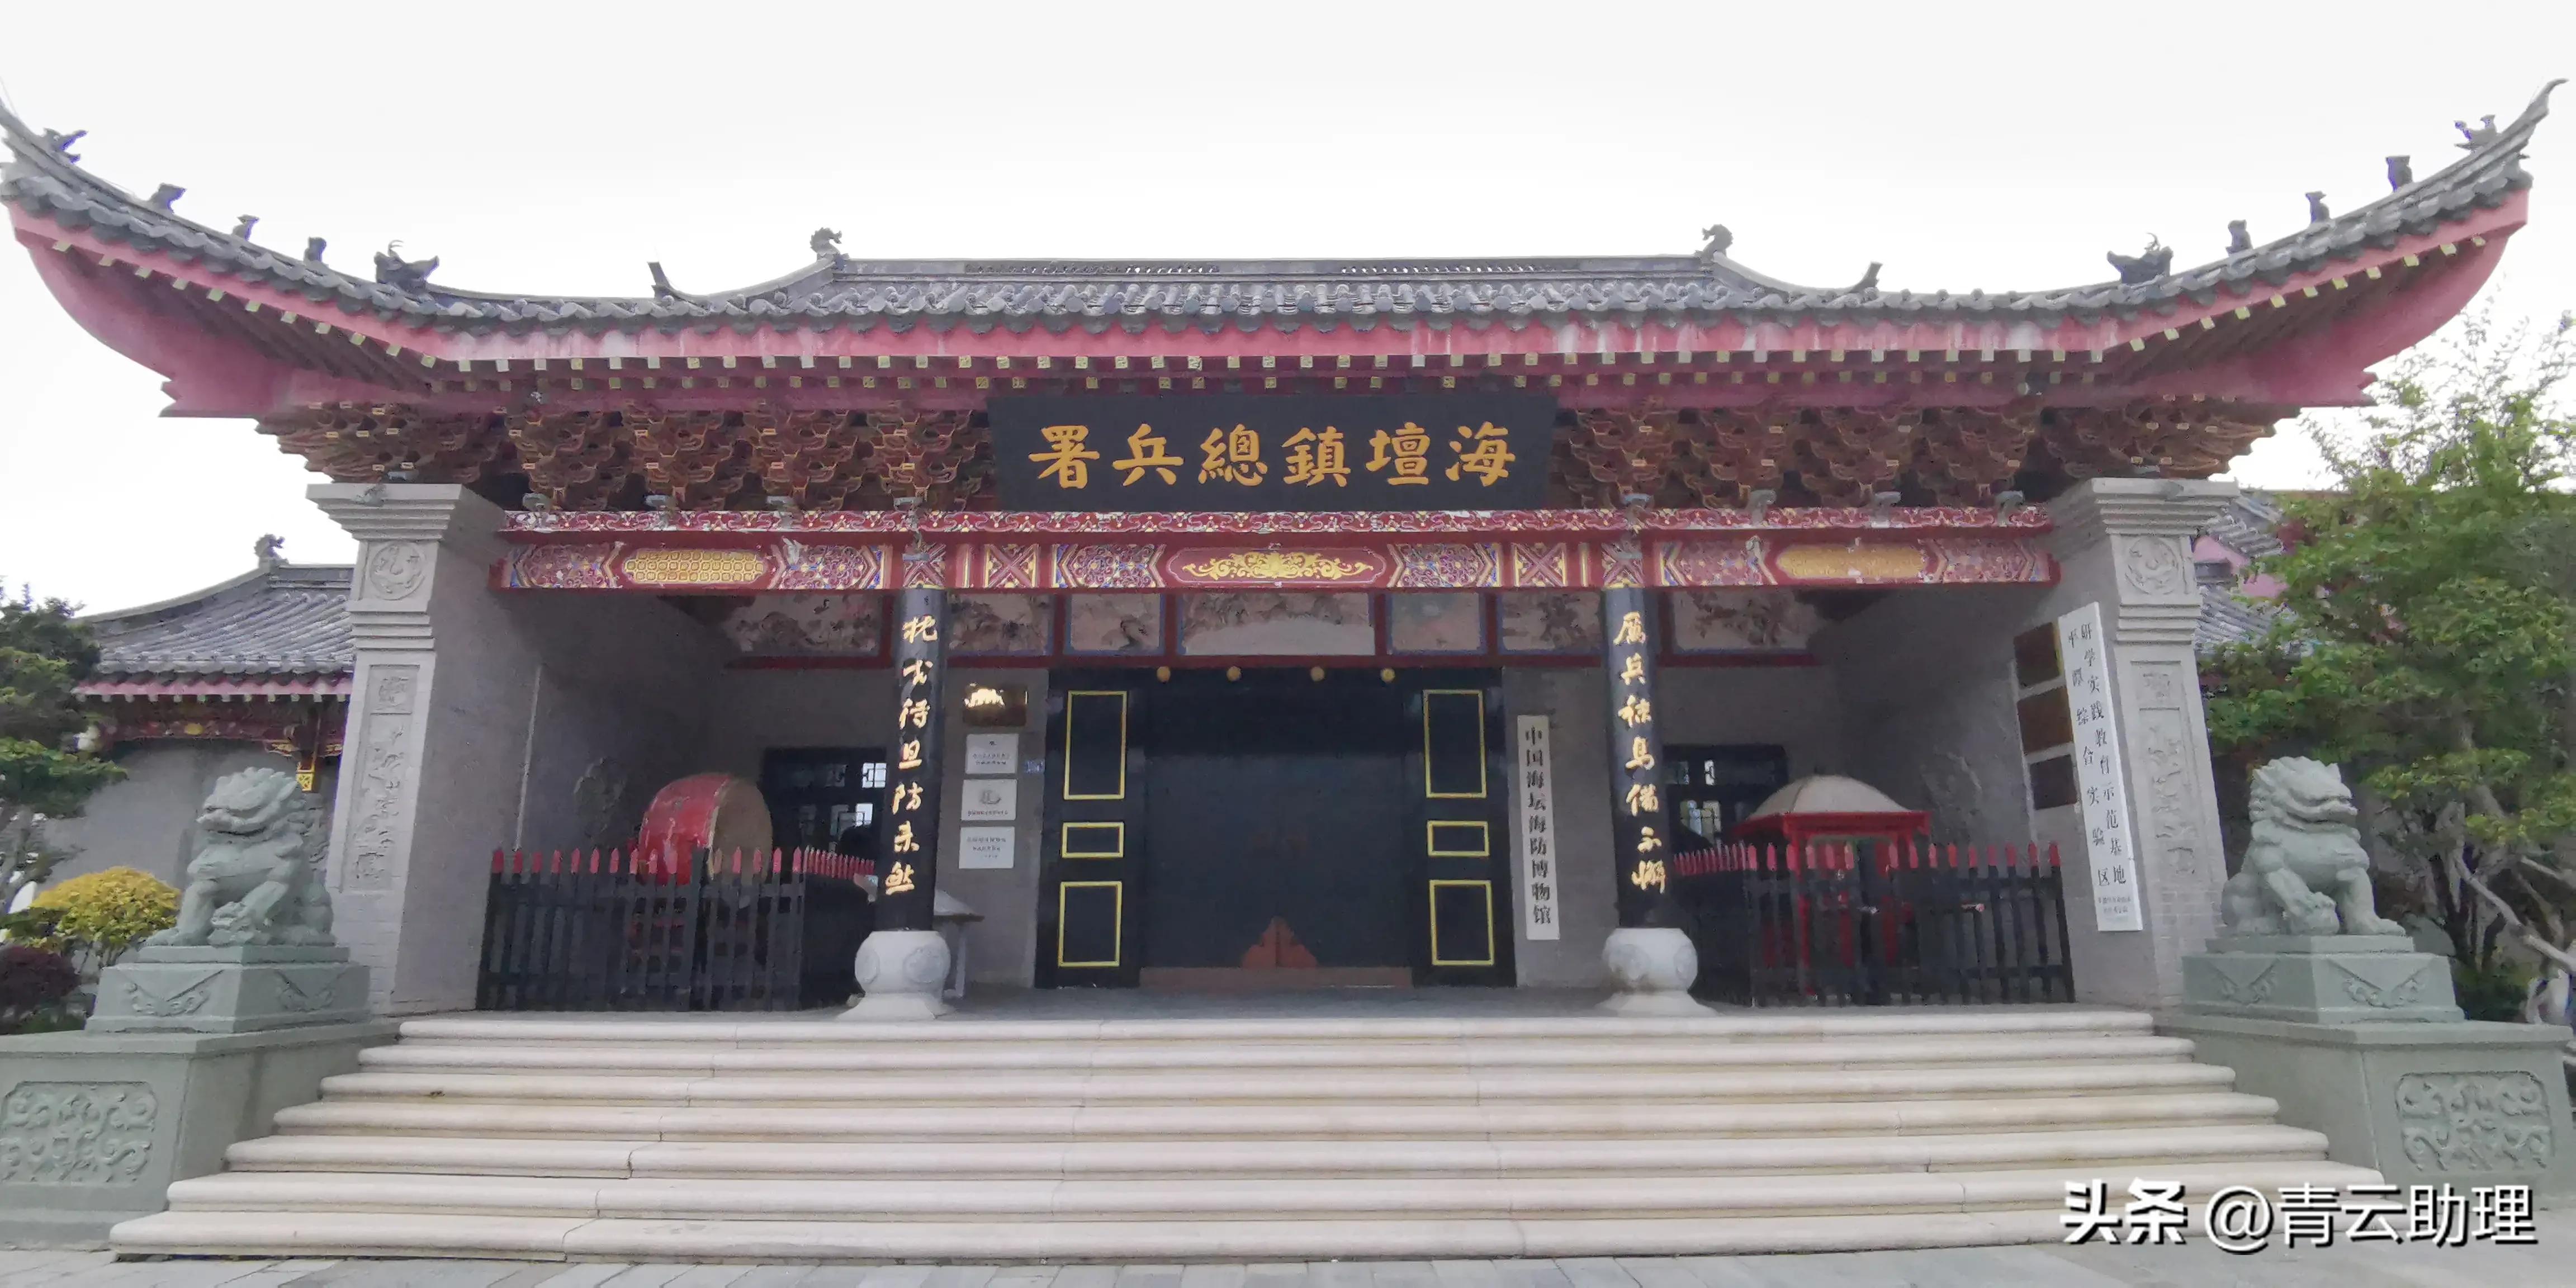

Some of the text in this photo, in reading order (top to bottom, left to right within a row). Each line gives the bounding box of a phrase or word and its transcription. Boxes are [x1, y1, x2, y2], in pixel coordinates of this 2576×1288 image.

[1524, 726, 1551, 925] 中国海坛海防博物馆
[2081, 622, 2126, 886] 研学实践教育示范基地
